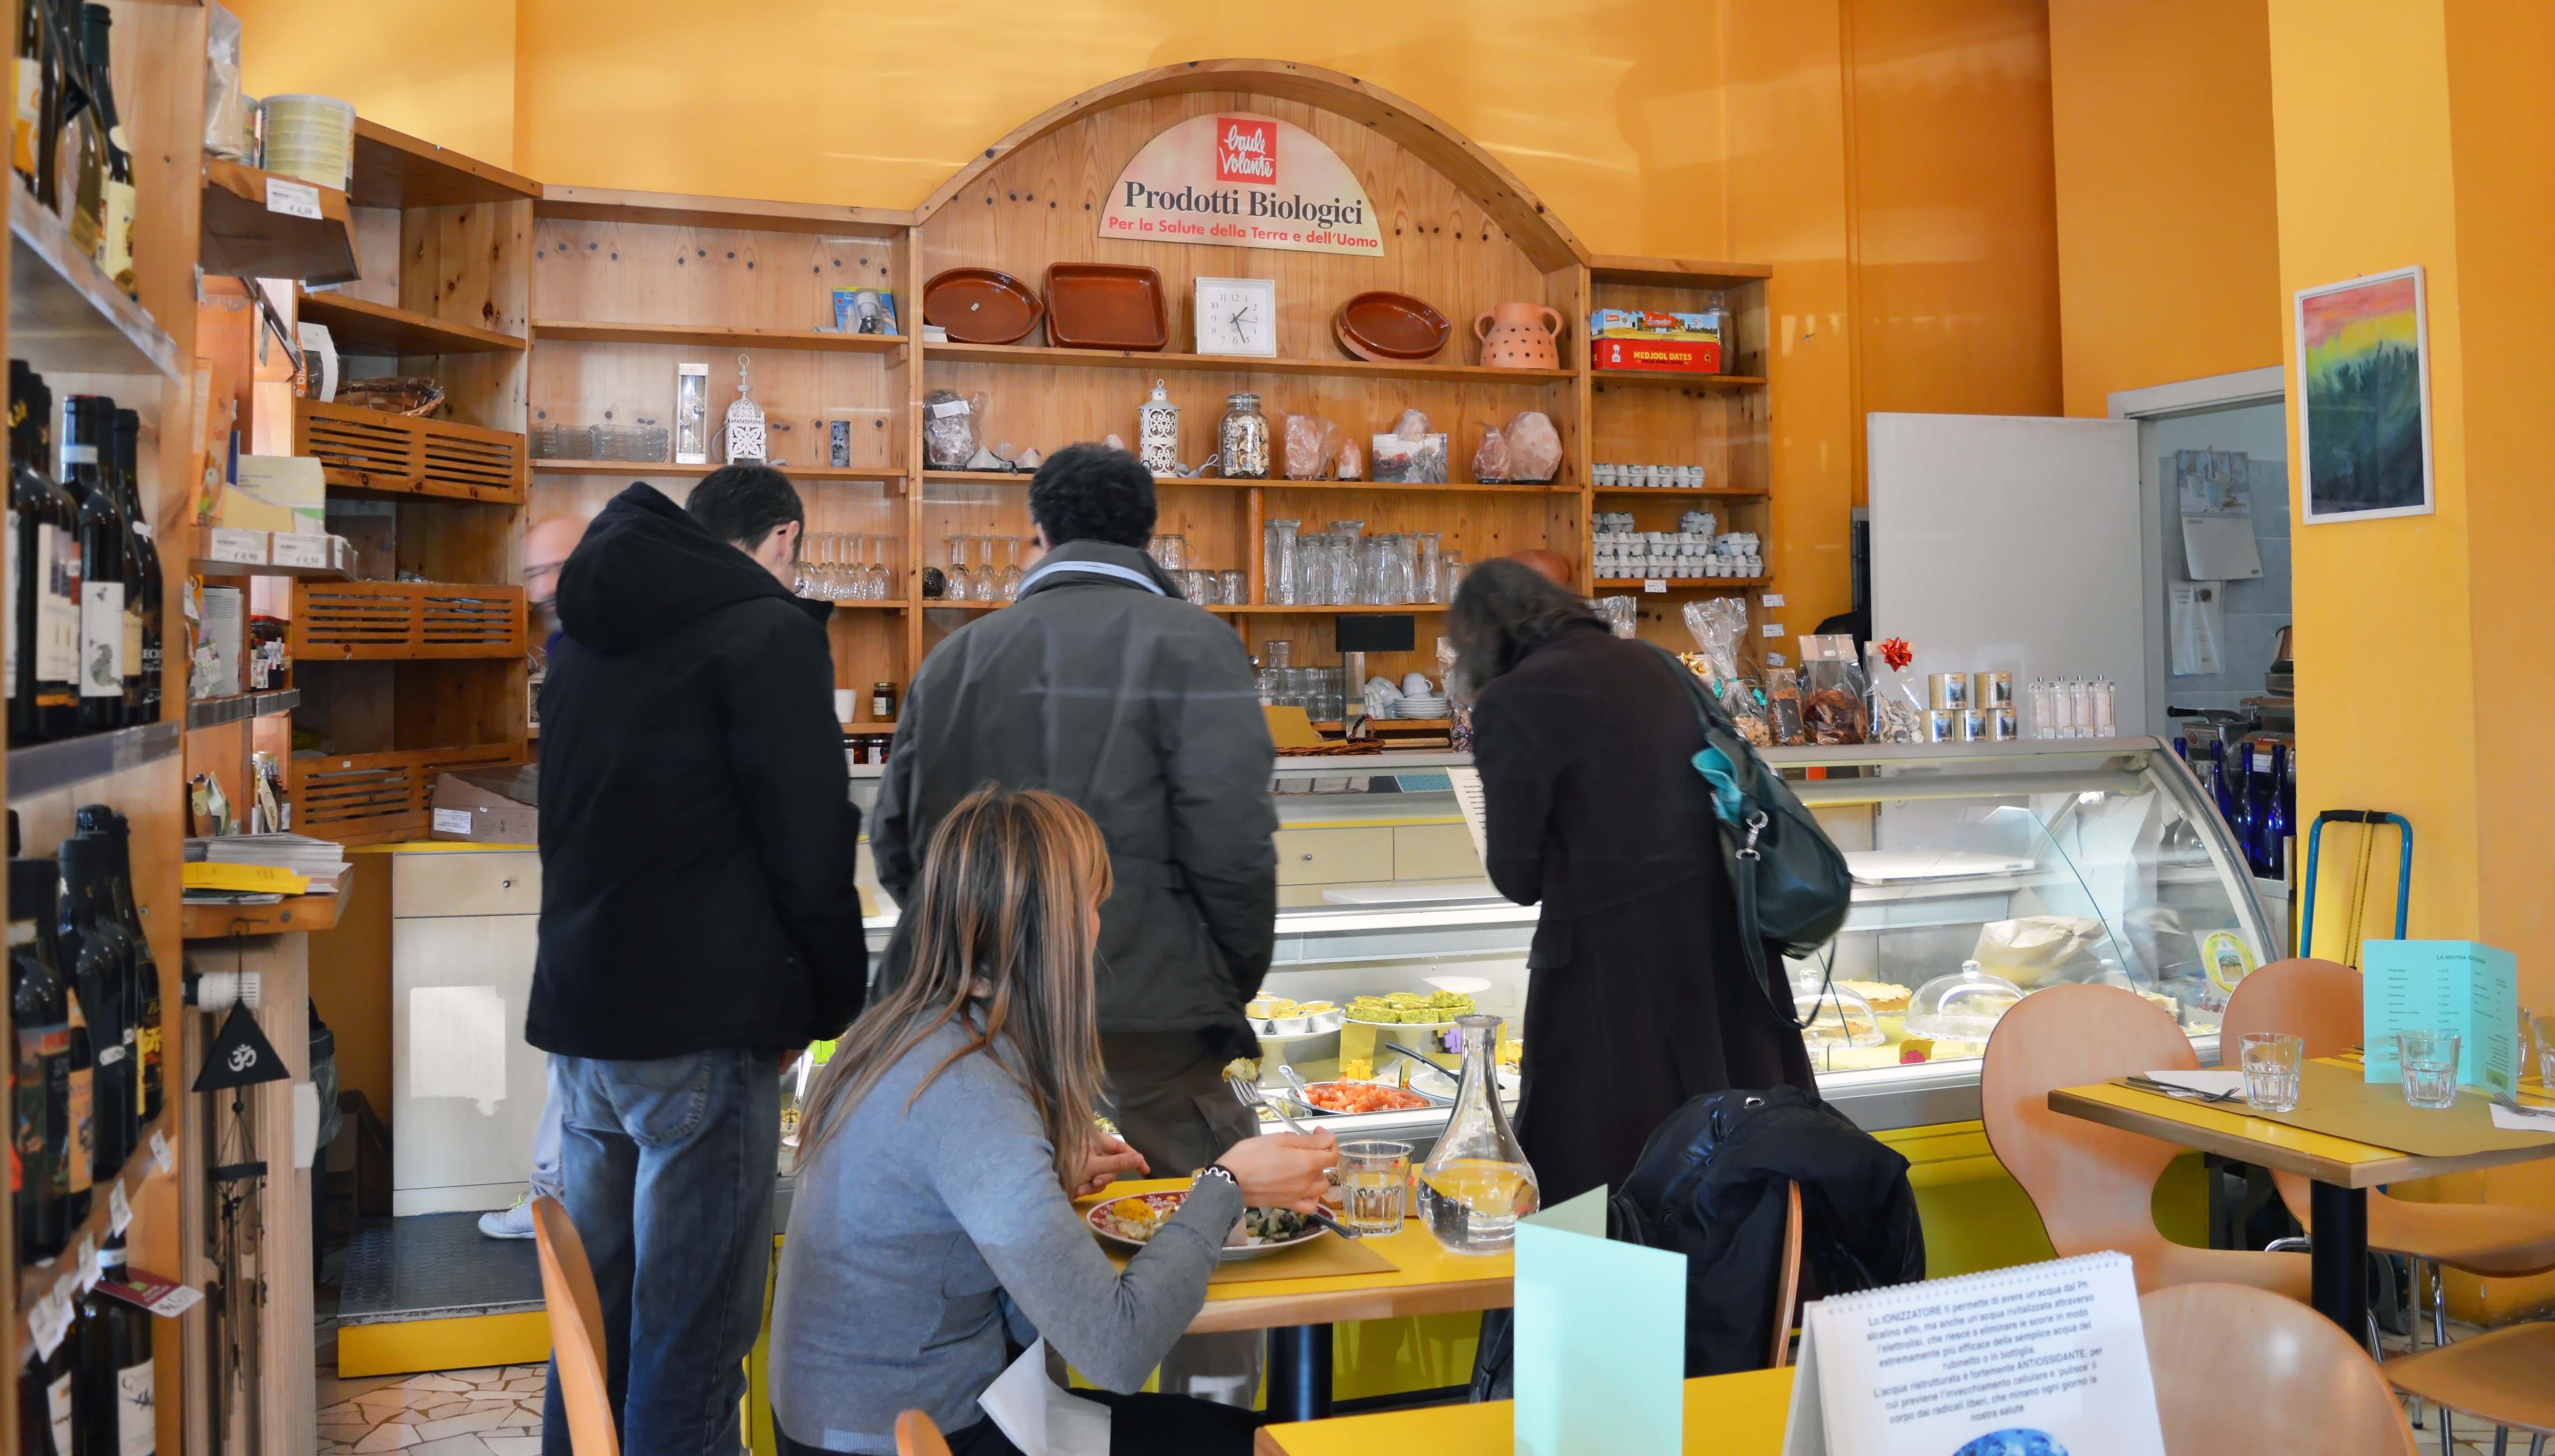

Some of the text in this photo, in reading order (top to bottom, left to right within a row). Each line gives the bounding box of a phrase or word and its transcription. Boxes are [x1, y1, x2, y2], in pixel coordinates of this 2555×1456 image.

[1124, 181, 1362, 229] Prodotti Biologici
[1109, 217, 1378, 248] Per la Salute della Terra e dell'Uomo
[1647, 316, 1672, 326] demeter
[1634, 351, 1667, 360] MEDJOOL
[1868, 1329, 1900, 1341] alcalino
[1940, 1317, 1964, 1328] anche
[2055, 1295, 2094, 1307] attraverso
[1869, 1317, 1879, 1326] Lo
[1882, 1306, 1942, 1323] IONIZZATORE
[1953, 1299, 1988, 1313] permette
[1992, 1296, 1998, 1305] di
[2002, 1294, 2023, 1303] avere
[2064, 1283, 2075, 1292] dal
[2078, 1281, 2088, 1290] Ph
[1880, 1350, 1939, 1367] estremamente
[1958, 1340, 1990, 1353] efficace
[1993, 1336, 2012, 1346] della
[2015, 1330, 2051, 1342] semplice
[2054, 1325, 2077, 1335] acqua
[2079, 1321, 2091, 1330] del
[1927, 1336, 1942, 1344] che
[1980, 1322, 2017, 1335] eliminare
[2029, 1315, 2053, 1325] scorie
[2066, 1309, 2088, 1318] modo
[1942, 1357, 1980, 1369] rubinetto
[1970, 1365, 2014, 1378] fortemente
[2090, 1348, 2102, 1358] per
[1889, 1413, 1914, 1424] corpo
[1932, 1401, 1964, 1415] radicali
[1992, 1394, 2006, 1403] che
[2009, 1388, 2039, 1399] minano
[2041, 1383, 2059, 1394] ogni
[2062, 1378, 2088, 1392] giorno
[1901, 1393, 1938, 1408] previene
[2013, 1372, 2048, 1384] cellulare
[1970, 1404, 2024, 1421] nostra salute
